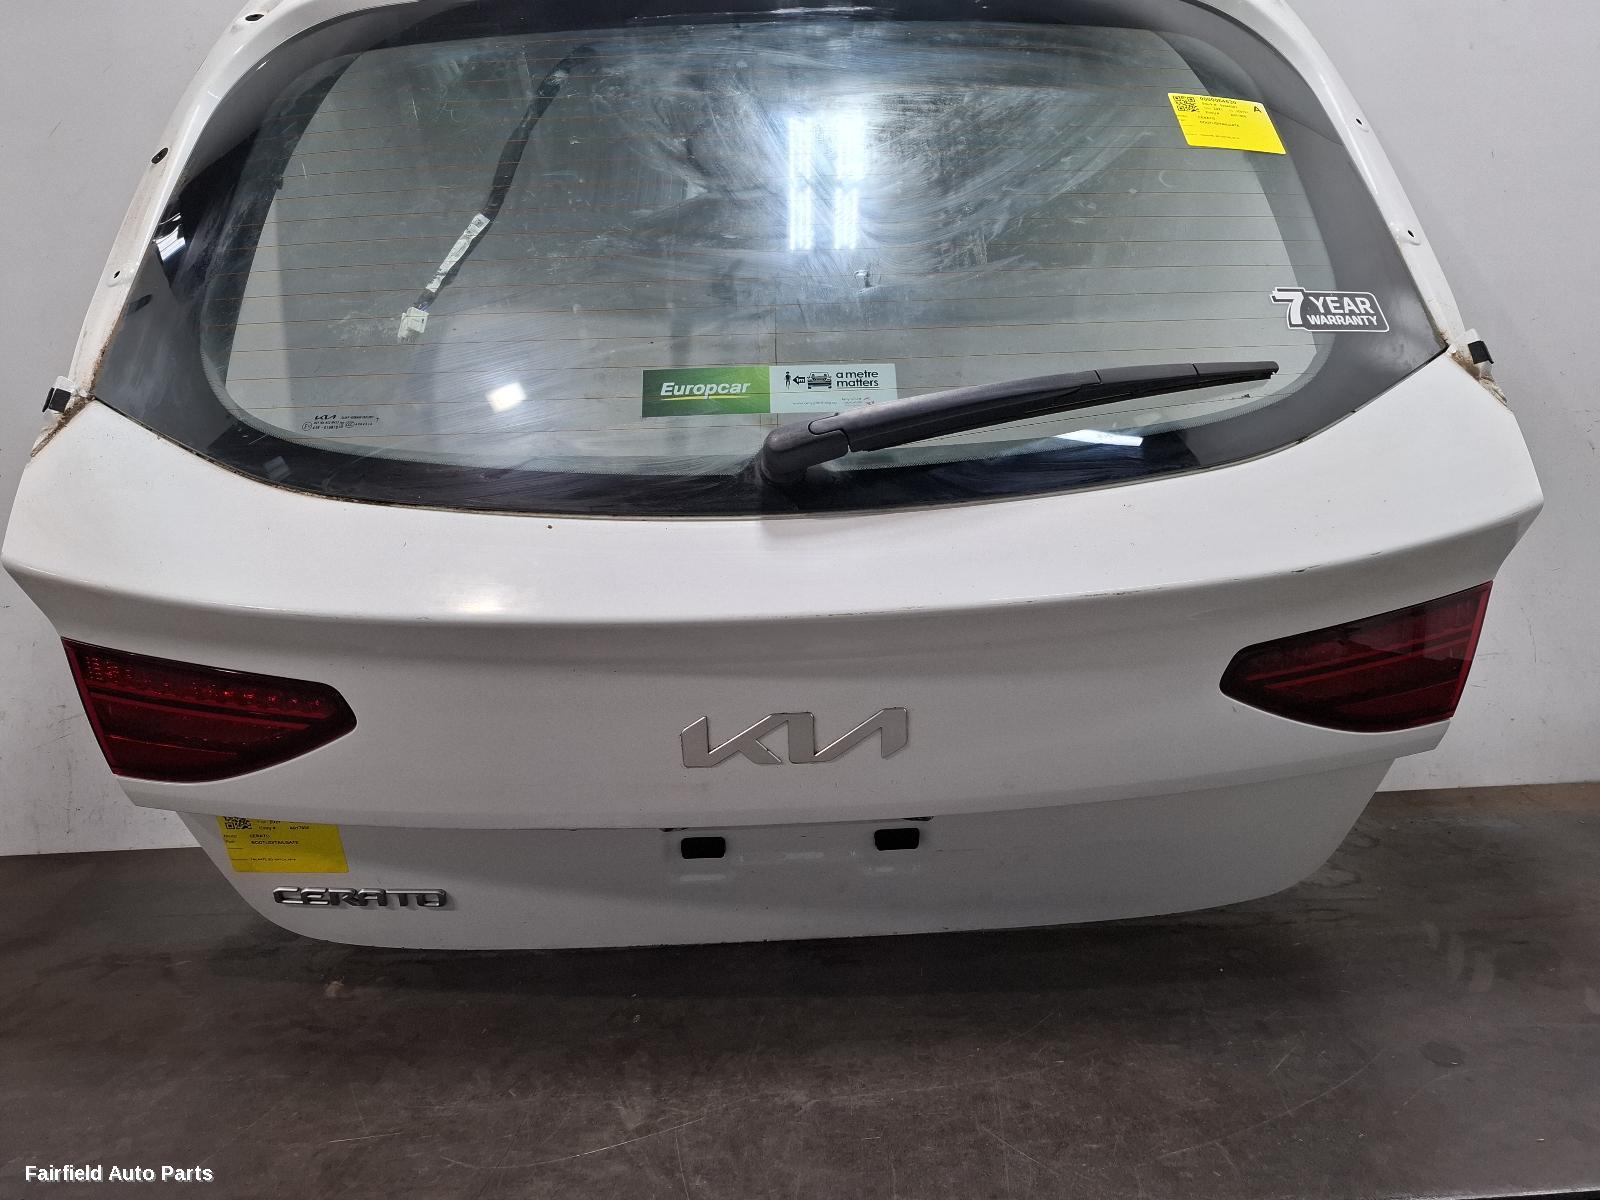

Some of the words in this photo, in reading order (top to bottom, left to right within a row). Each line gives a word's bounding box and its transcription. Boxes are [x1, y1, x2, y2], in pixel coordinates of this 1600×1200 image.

[1270, 288, 1305, 327] 7
[1308, 296, 1376, 314] YEAR
[1306, 314, 1378, 326] WARRANTY
[836, 371, 844, 379] a
[845, 369, 879, 379] metre
[836, 379, 879, 387] matters
[660, 382, 752, 400] Europcar
[680, 707, 909, 768] KIA
[273, 886, 447, 907] CERATO
